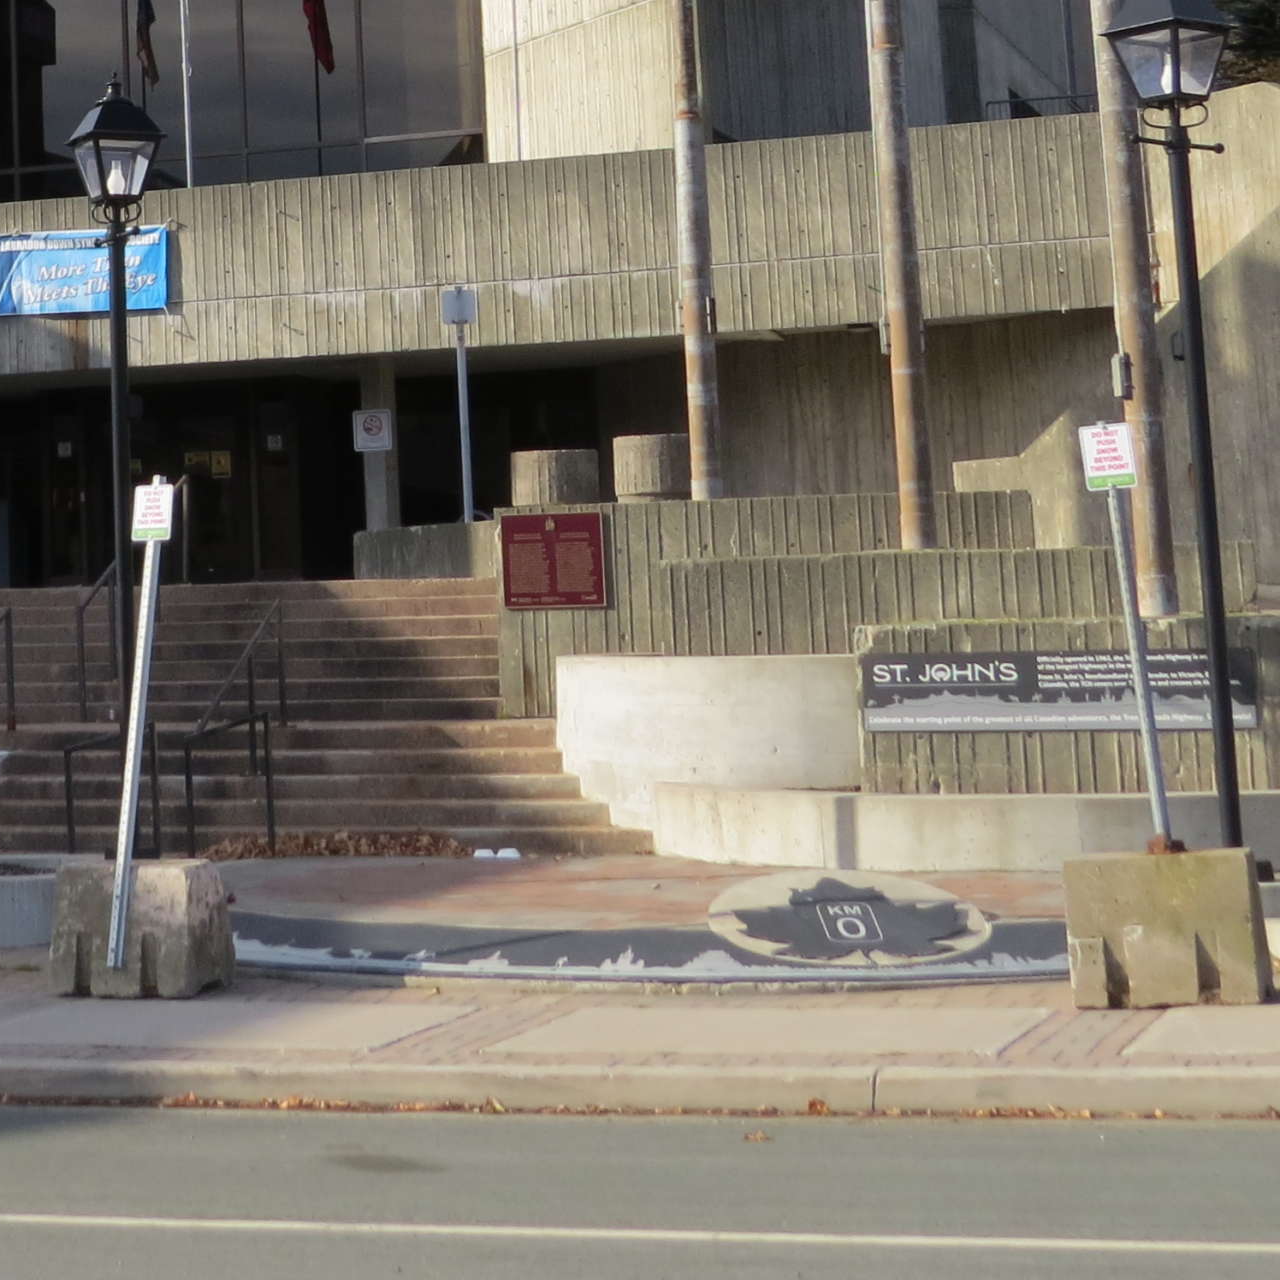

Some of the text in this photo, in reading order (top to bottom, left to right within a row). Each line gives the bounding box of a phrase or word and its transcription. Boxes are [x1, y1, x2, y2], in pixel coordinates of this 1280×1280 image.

[0, 238, 46, 252] LABRADOR
[47, 238, 74, 250] DOWN
[37, 254, 142, 282] More Thn
[23, 271, 157, 306] Meets Th Eye
[872, 660, 1019, 683] ST. JOHN'S
[826, 904, 862, 916] KM
[836, 917, 866, 939] 0
